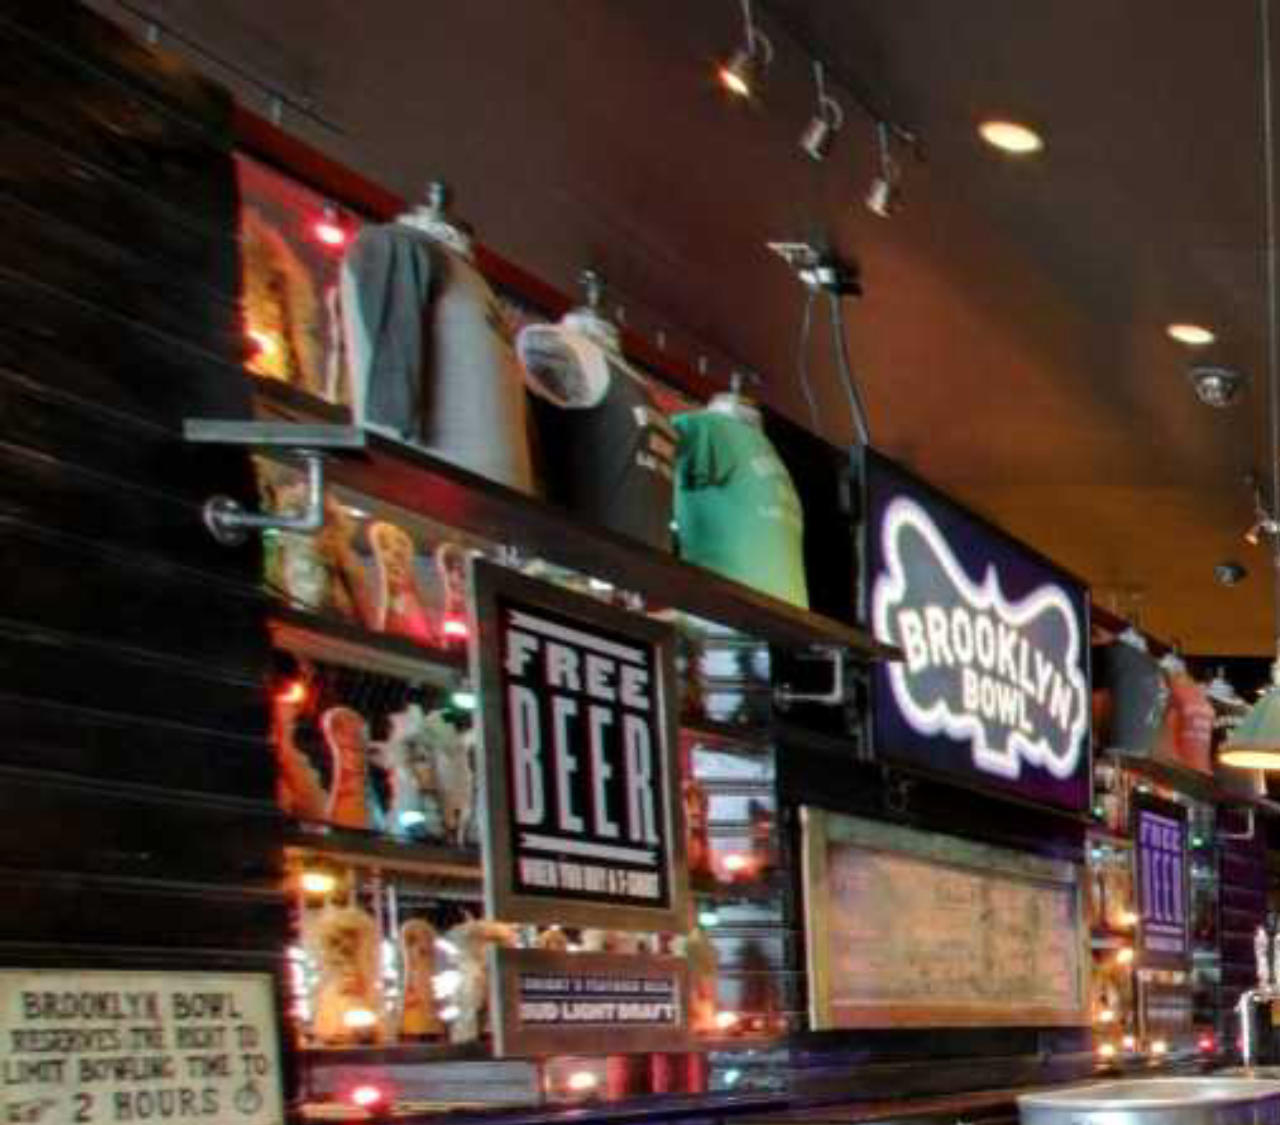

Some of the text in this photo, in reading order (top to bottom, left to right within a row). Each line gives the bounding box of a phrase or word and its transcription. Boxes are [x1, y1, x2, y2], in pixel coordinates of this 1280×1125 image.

[505, 630, 650, 710] FREE
[899, 606, 1072, 730] BROOKLYN
[962, 667, 1032, 732] BOWL
[508, 683, 661, 845] BEER
[22, 990, 242, 1020] BROOKLYN BOWL
[561, 1002, 614, 1021] LIGHT
[10, 1026, 121, 1051] RESERVES
[130, 1027, 163, 1050] THE
[235, 1024, 260, 1048] TO
[2, 1053, 268, 1085] LIMIT BOWLING TIME TO
[73, 1087, 220, 1123] 2 HOURS
